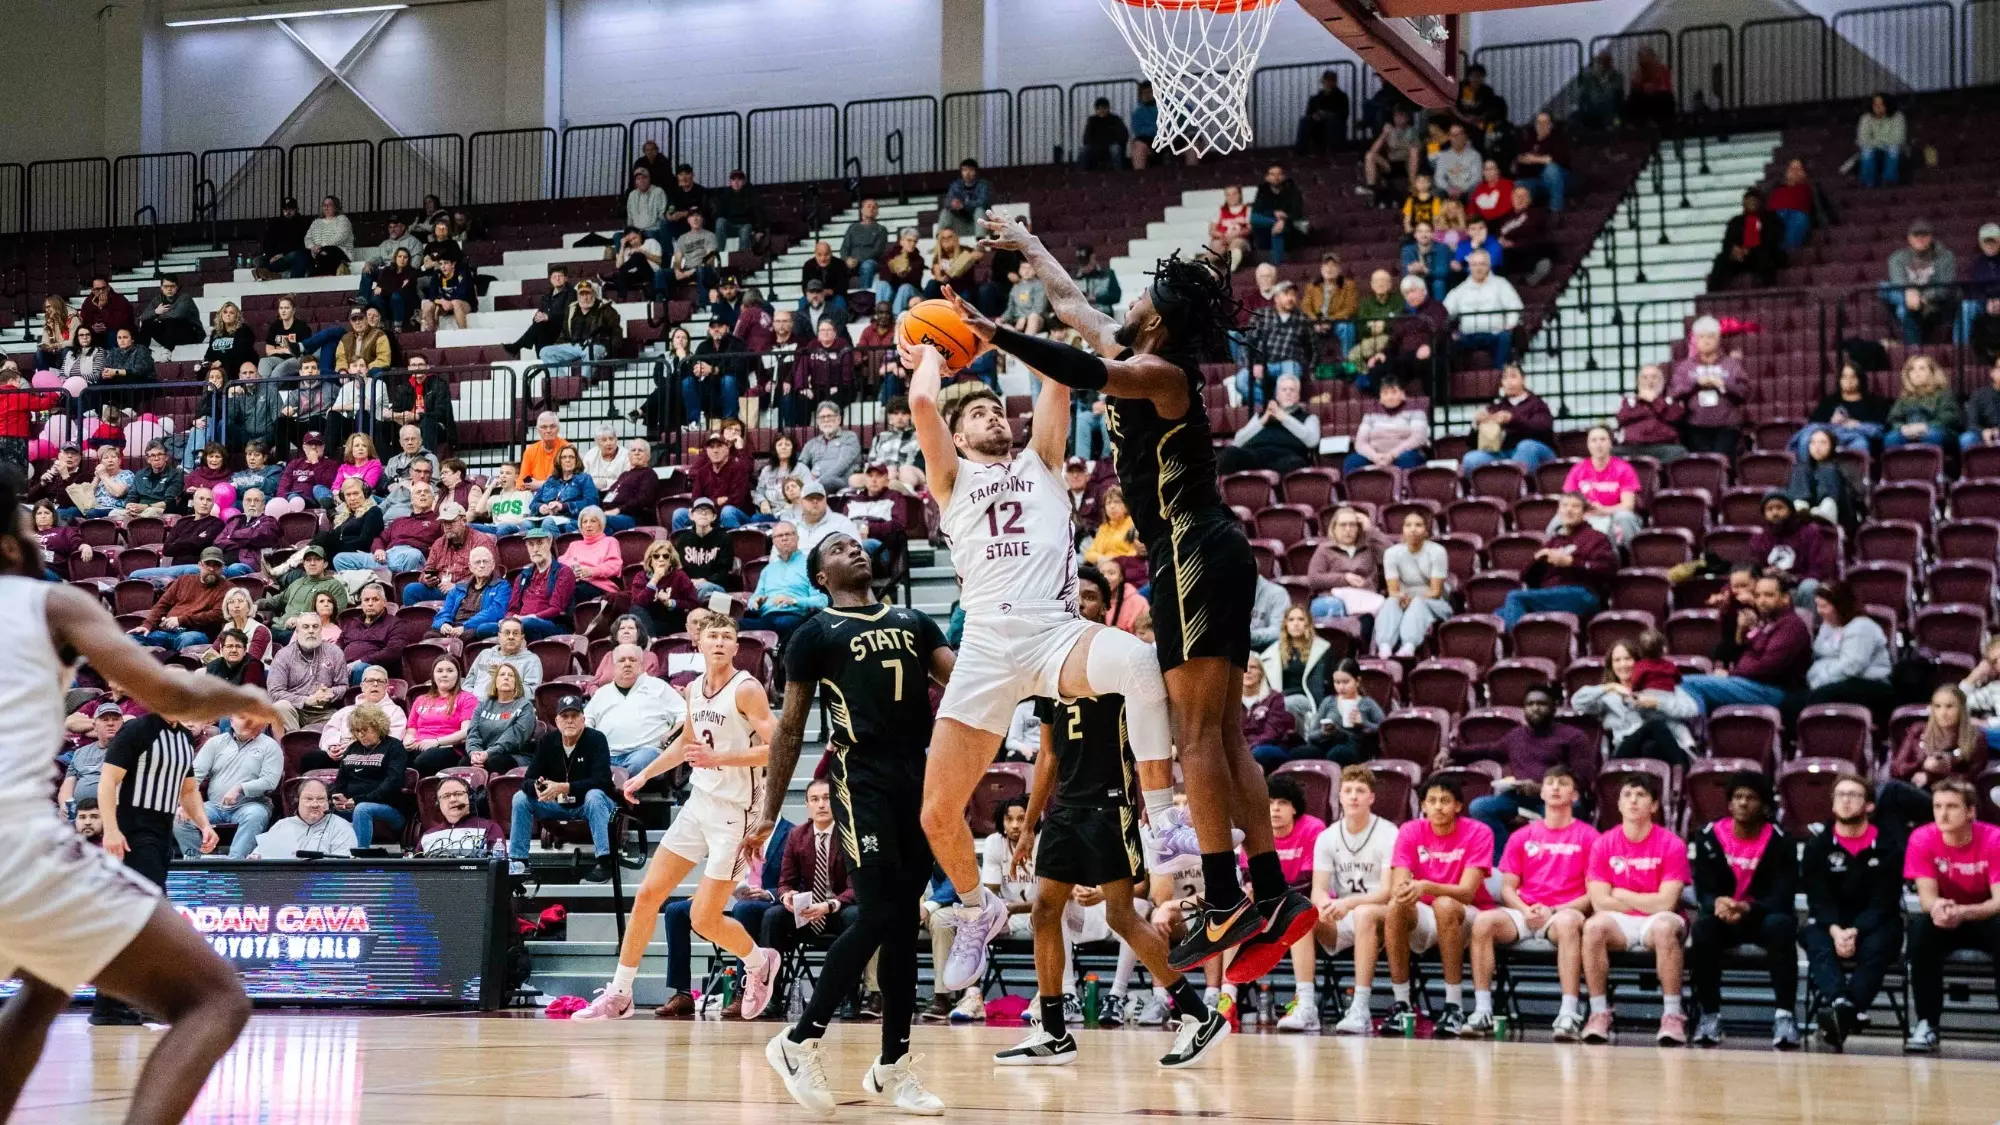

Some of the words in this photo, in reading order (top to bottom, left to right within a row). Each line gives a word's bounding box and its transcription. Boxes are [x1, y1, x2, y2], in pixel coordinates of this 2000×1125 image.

[985, 501, 1025, 537] 12
[986, 541, 1030, 560] STATE
[850, 628, 918, 661] STATE
[881, 658, 904, 701] 7
[1067, 705, 1083, 740] 2
[276, 906, 370, 933] CAVA
[287, 936, 361, 959] WORLD
